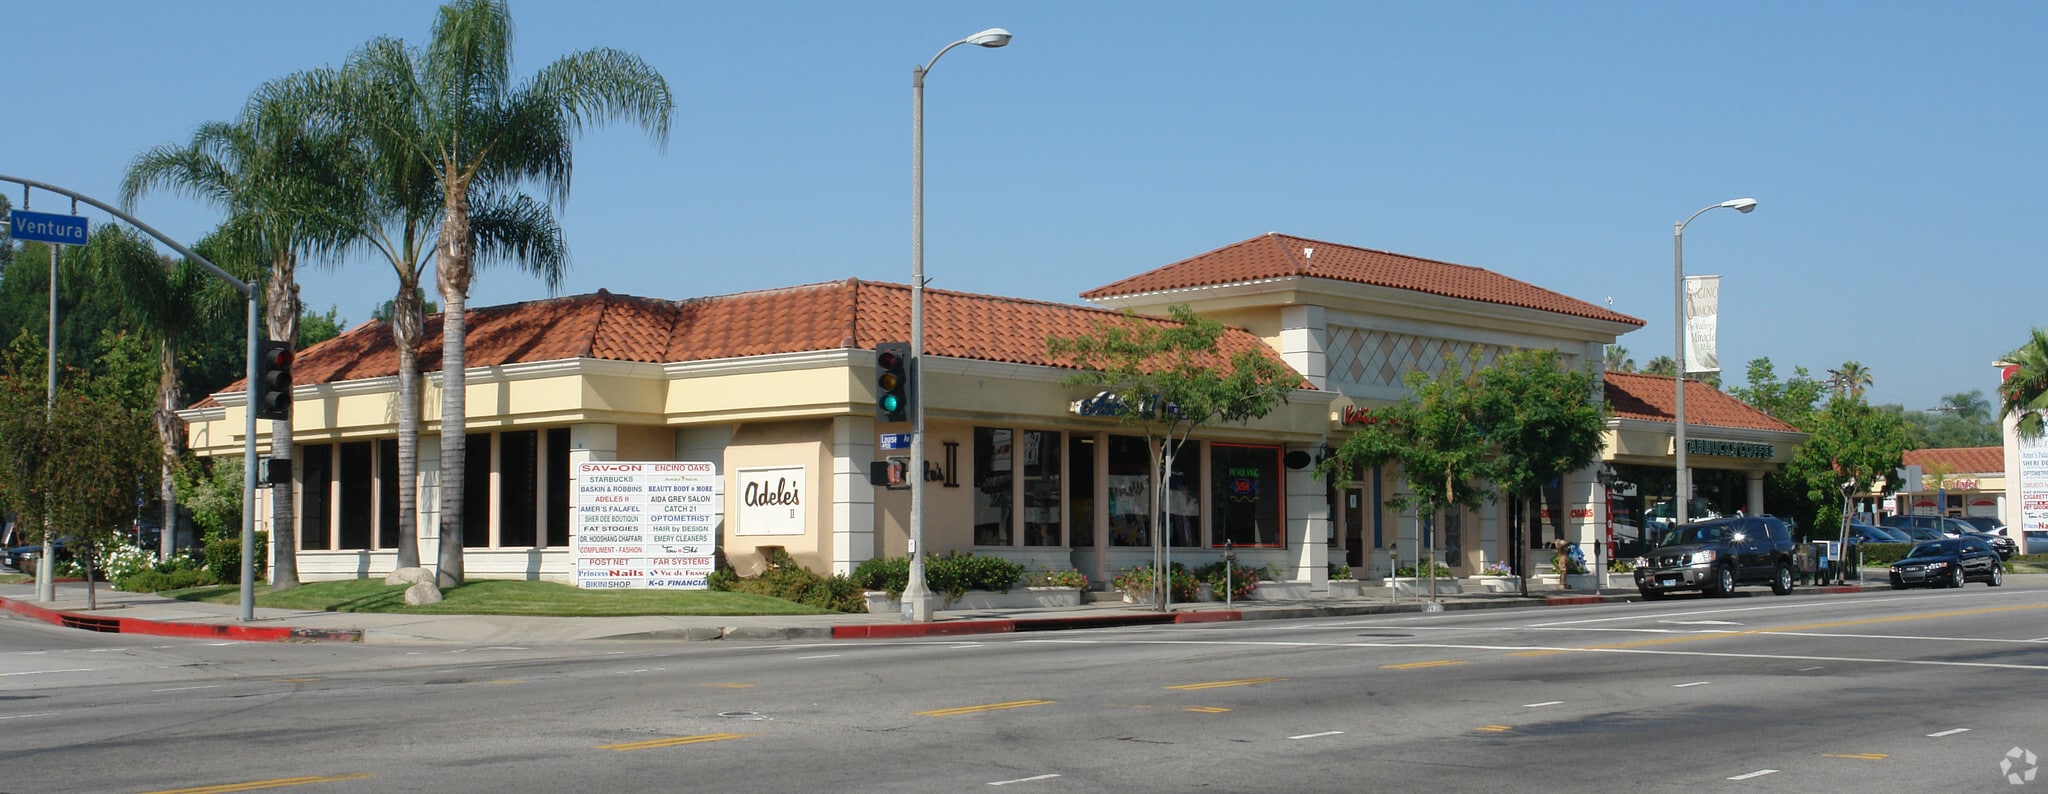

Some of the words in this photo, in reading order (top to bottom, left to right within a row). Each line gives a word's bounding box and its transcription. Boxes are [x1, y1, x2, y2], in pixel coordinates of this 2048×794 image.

[16, 217, 83, 238] Ventura
[1687, 281, 1718, 299] ENCINO
[1674, 438, 1738, 457] TARBUCKS
[1739, 442, 1776, 458] COFFEE
[582, 464, 642, 472] SAV-ON
[655, 464, 686, 472] ENCINO
[687, 464, 711, 472] OAKS
[745, 477, 800, 507] Adele's
[650, 495, 667, 503] AIDA
[668, 495, 687, 503] GREY
[688, 495, 711, 503] SALON
[664, 505, 688, 513] CATCH
[689, 505, 697, 513] 21
[653, 535, 675, 543] EMERY
[675, 535, 708, 543] CLEANERS
[589, 558, 611, 566] POST
[612, 558, 630, 566] NET
[653, 558, 670, 566] FAR
[671, 557, 711, 566] SYSTEMS
[608, 580, 631, 588] SHOP
